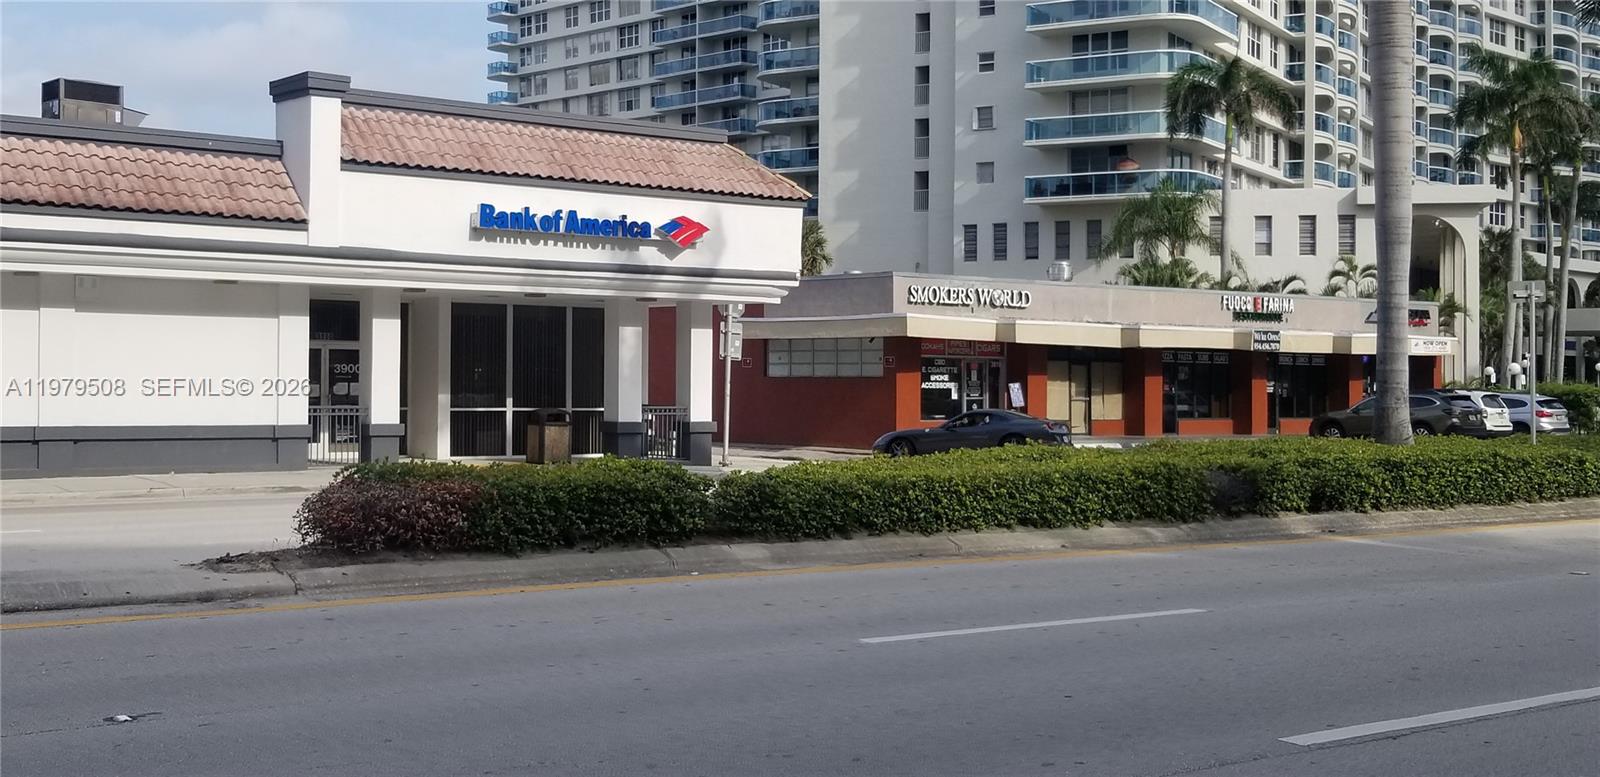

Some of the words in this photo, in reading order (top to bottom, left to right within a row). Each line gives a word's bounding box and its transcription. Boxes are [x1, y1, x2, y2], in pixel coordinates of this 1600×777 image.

[478, 203, 538, 231] Bank
[538, 210, 563, 233] of
[563, 209, 652, 238] America
[909, 285, 974, 305] SMOKERS
[977, 288, 1032, 307] WORLD
[1222, 295, 1252, 310] FUOCO
[1263, 297, 1294, 312] FARINA
